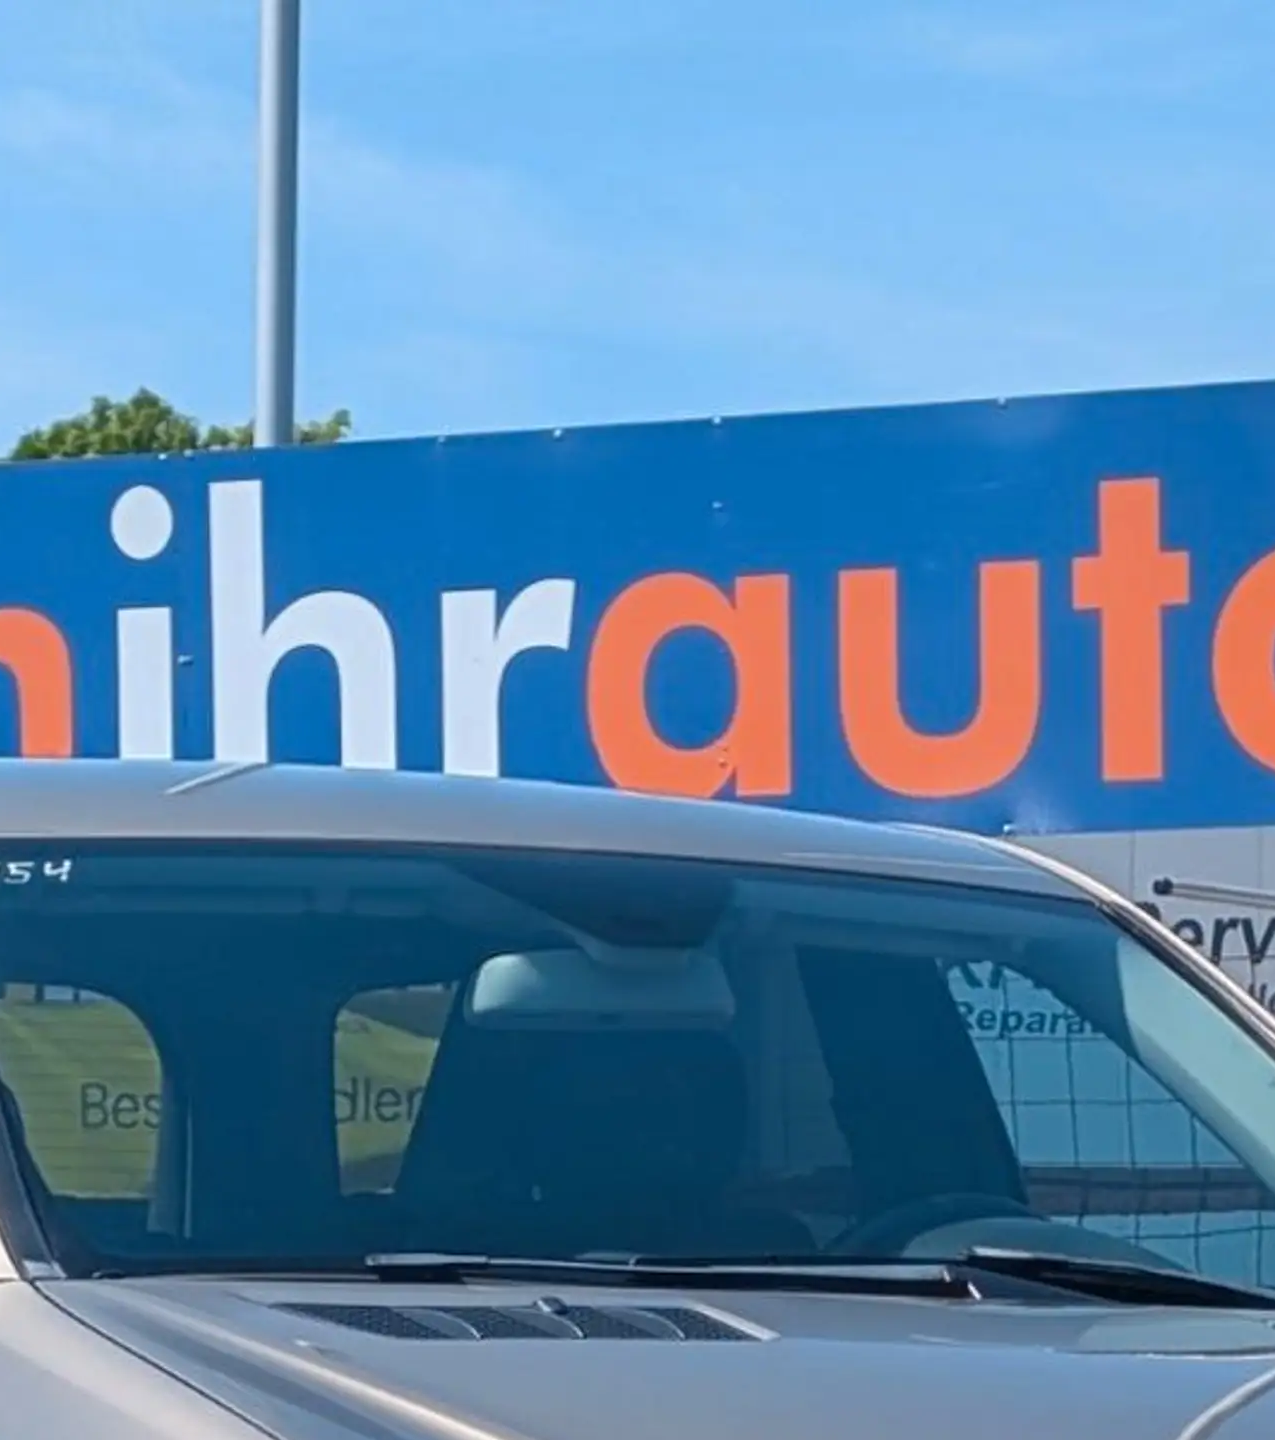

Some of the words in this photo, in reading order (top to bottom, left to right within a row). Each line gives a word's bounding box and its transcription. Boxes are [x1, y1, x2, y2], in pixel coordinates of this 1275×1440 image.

[957, 1001, 1085, 1039] Repara
[81, 1081, 160, 1129] Bes
[335, 1077, 426, 1124] dler
